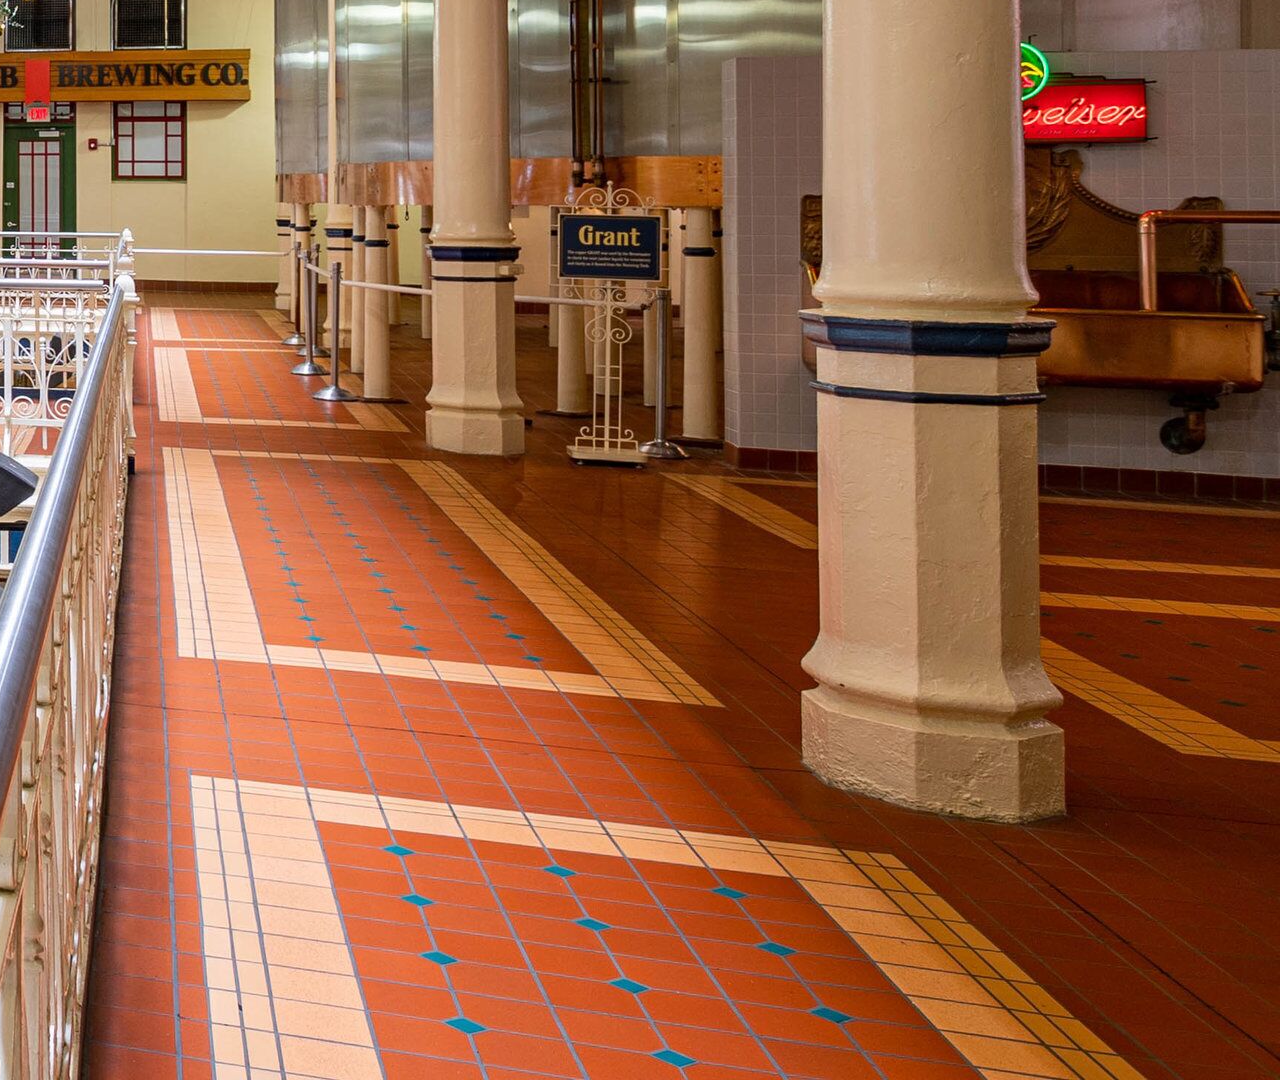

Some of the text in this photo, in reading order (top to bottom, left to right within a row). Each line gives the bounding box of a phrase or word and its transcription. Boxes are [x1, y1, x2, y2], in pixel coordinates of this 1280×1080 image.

[56, 62, 196, 87] BREWING
[200, 61, 250, 87] CO.
[29, 107, 47, 121] EXIT
[577, 224, 641, 247] Grant
